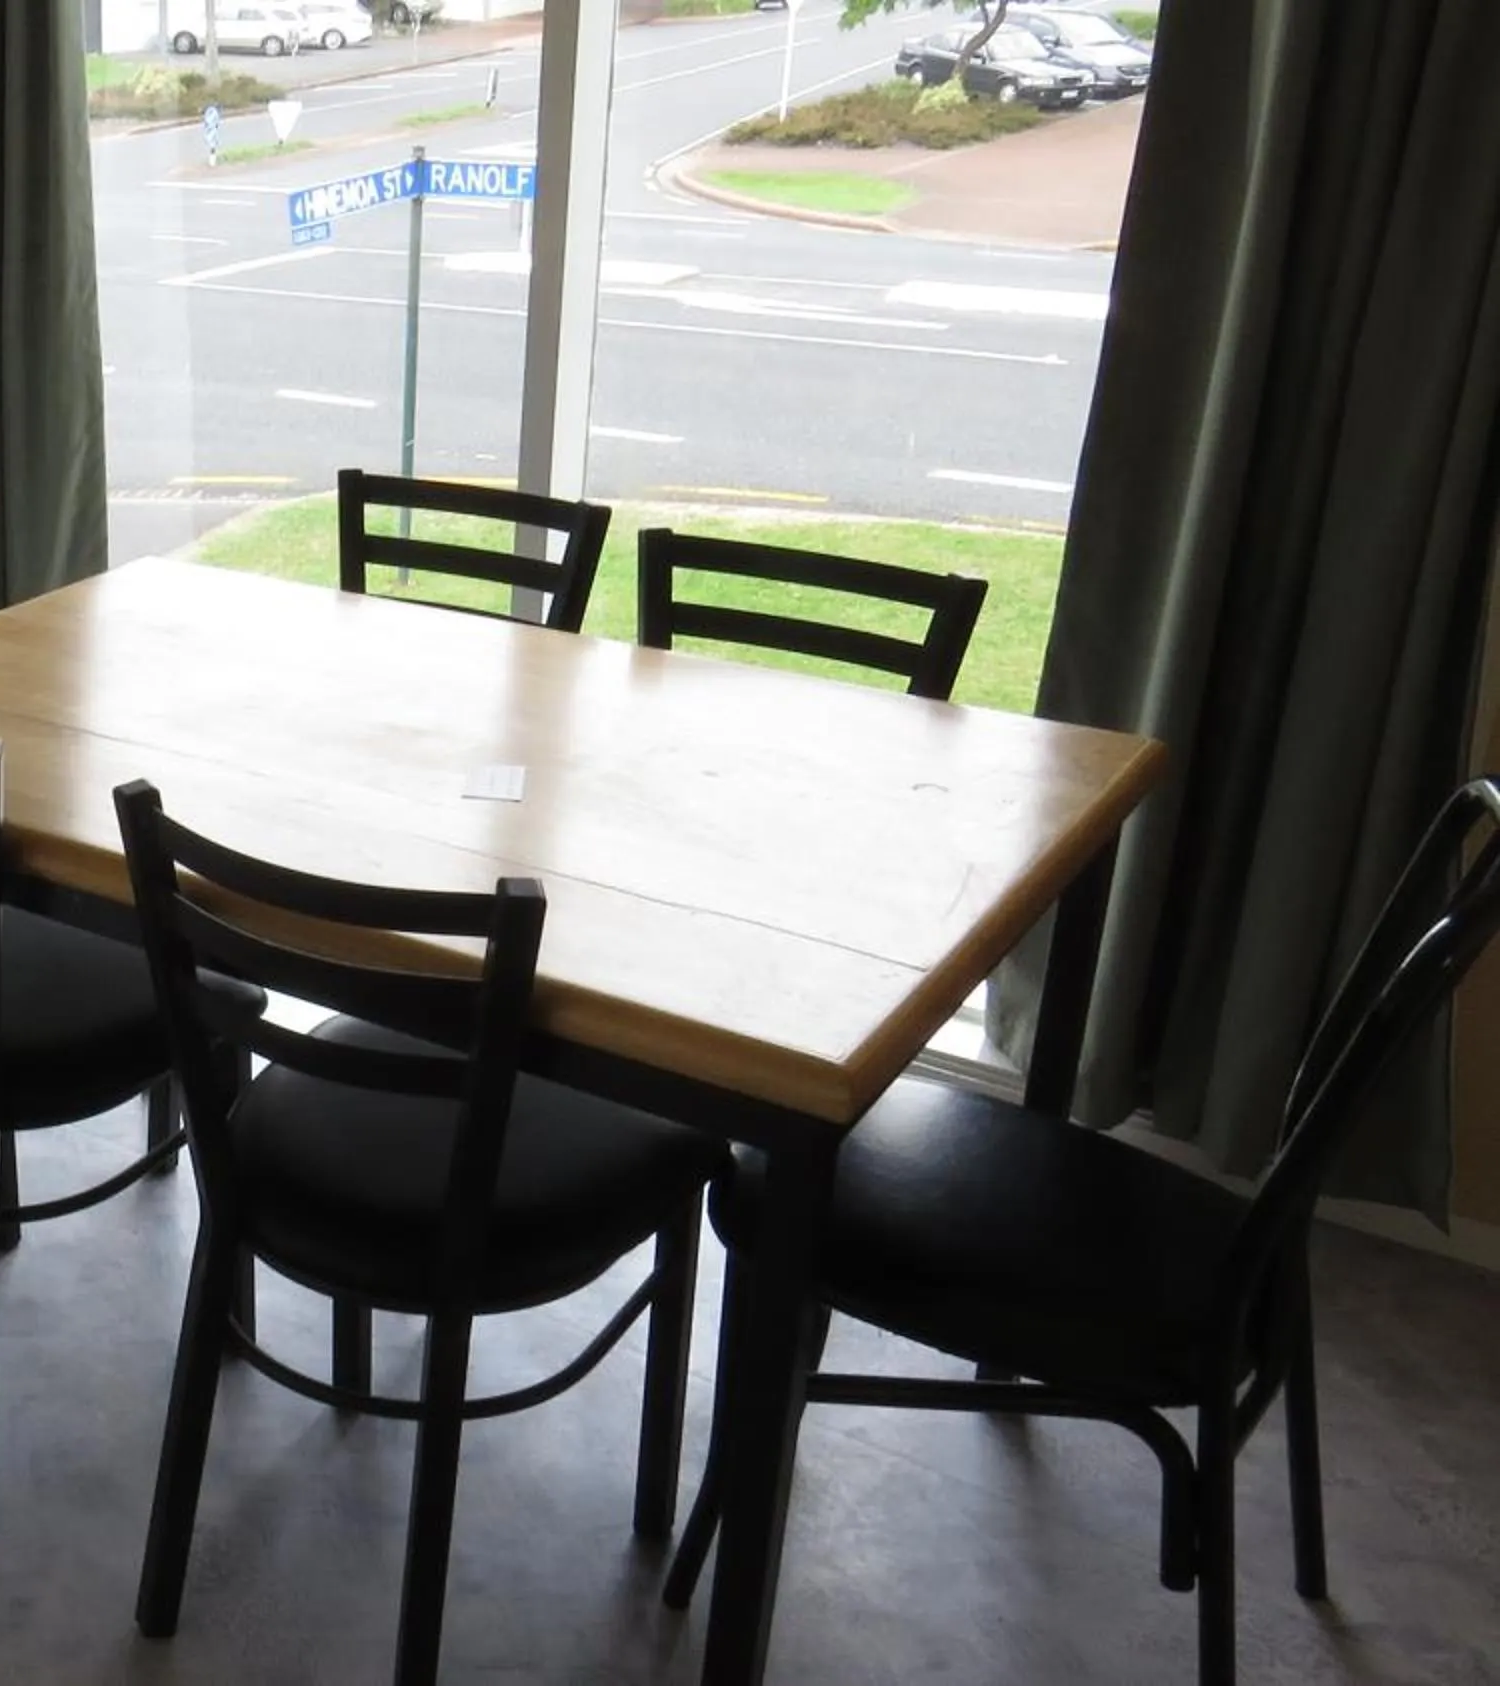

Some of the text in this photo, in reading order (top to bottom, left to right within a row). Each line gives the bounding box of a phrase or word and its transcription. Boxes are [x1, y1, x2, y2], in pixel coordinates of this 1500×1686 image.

[303, 169, 402, 222] HINEMOA ST
[430, 164, 532, 193] RANOLF
